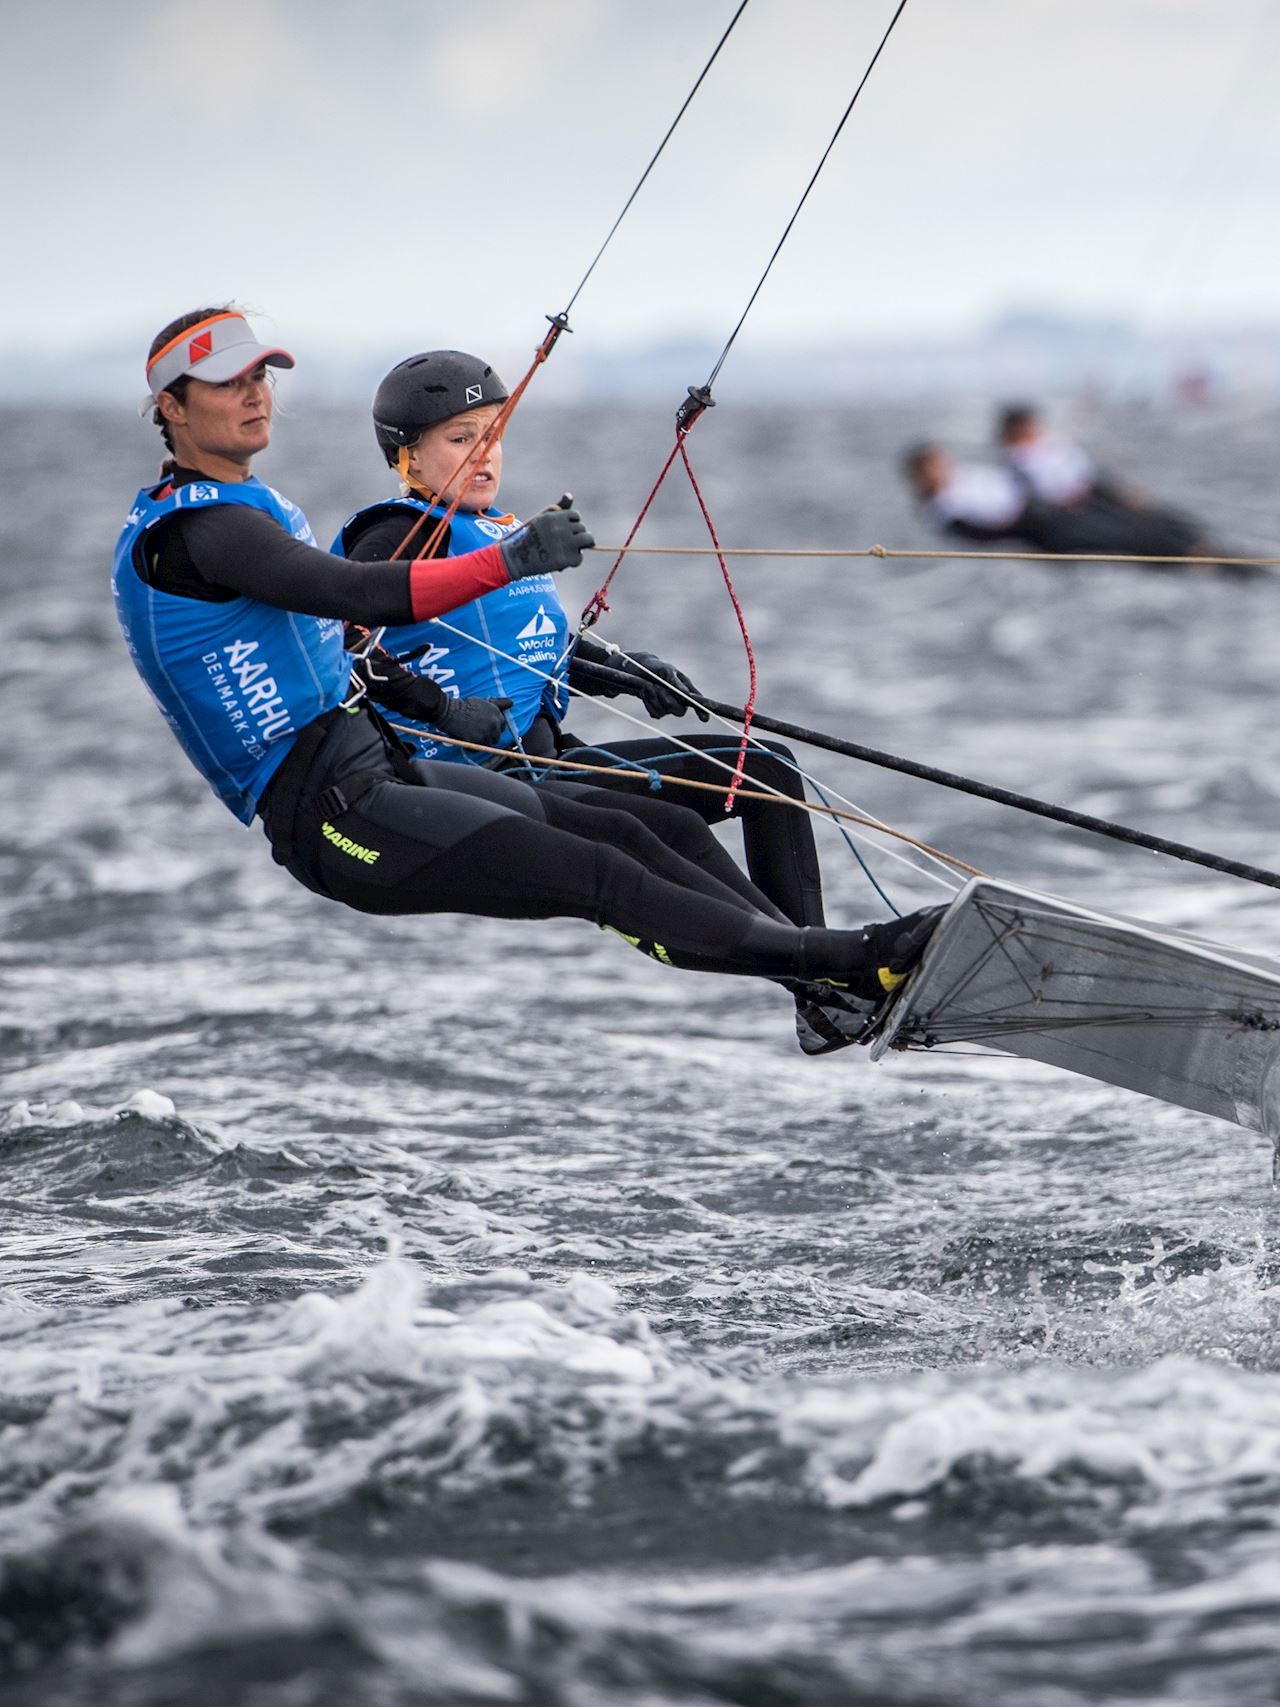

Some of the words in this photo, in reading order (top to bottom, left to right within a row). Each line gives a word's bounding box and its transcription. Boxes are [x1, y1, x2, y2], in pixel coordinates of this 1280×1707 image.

[518, 636, 554, 651] World
[518, 650, 558, 664] Sailing
[202, 651, 250, 734] DENMARK
[223, 639, 296, 744] AARHU
[321, 821, 380, 865] MARINE
